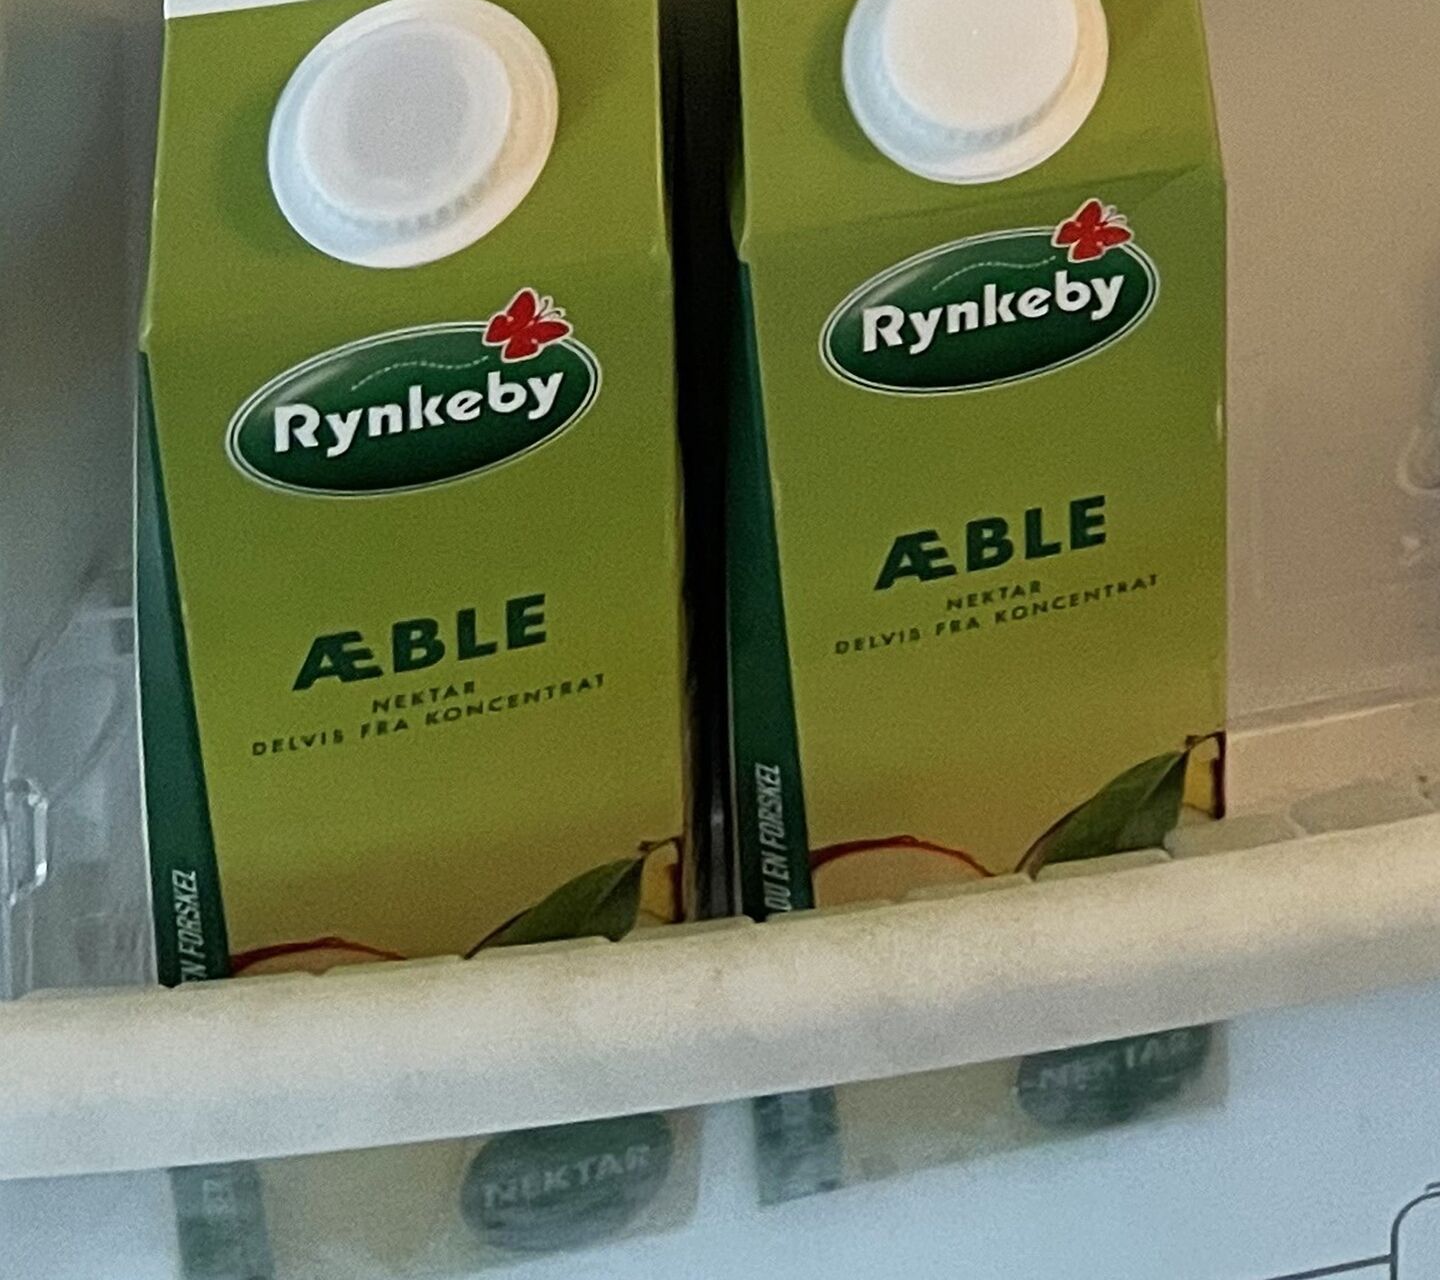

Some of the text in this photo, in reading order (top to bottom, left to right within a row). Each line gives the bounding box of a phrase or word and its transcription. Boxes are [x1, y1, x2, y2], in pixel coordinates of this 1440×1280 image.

[861, 269, 1126, 355] Rynkeby
[273, 370, 565, 459] Rynkeby
[874, 494, 1108, 592] ÆBLE
[834, 573, 1160, 655] DELVIS FRA KONCENTRAT
[945, 579, 1043, 612] NEKTAR
[291, 592, 549, 692] ÆBLE
[251, 672, 607, 757] DELVIS FRA KONCENTRAT
[371, 680, 477, 715] NEKTAR
[754, 761, 787, 851] FORSKEL
[761, 850, 792, 881] EN
[171, 868, 206, 957] FORSKEL
